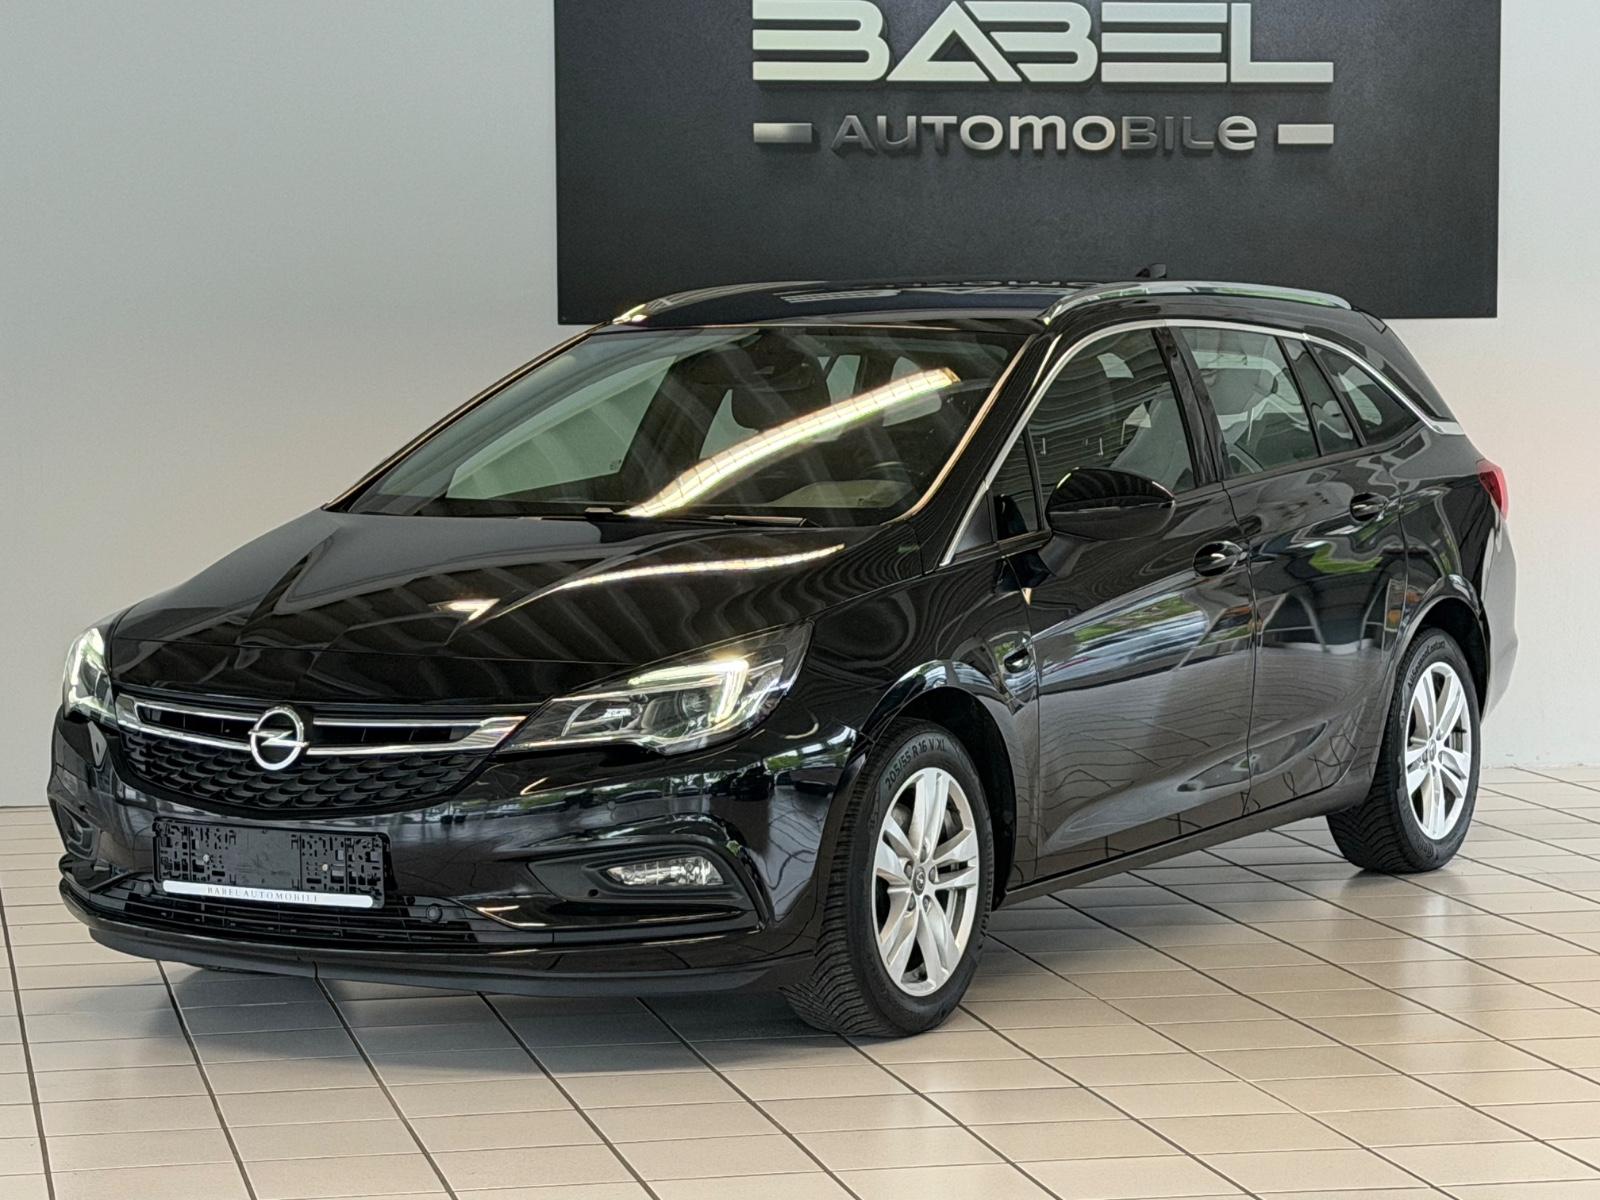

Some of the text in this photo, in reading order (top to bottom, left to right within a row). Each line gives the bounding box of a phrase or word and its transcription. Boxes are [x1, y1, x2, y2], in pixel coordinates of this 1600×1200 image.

[753, 0, 1334, 83] BABEL
[884, 751, 912, 790] 205/55
[911, 745, 919, 758] R
[919, 740, 928, 754] 16
[207, 886, 241, 897] BABEL
